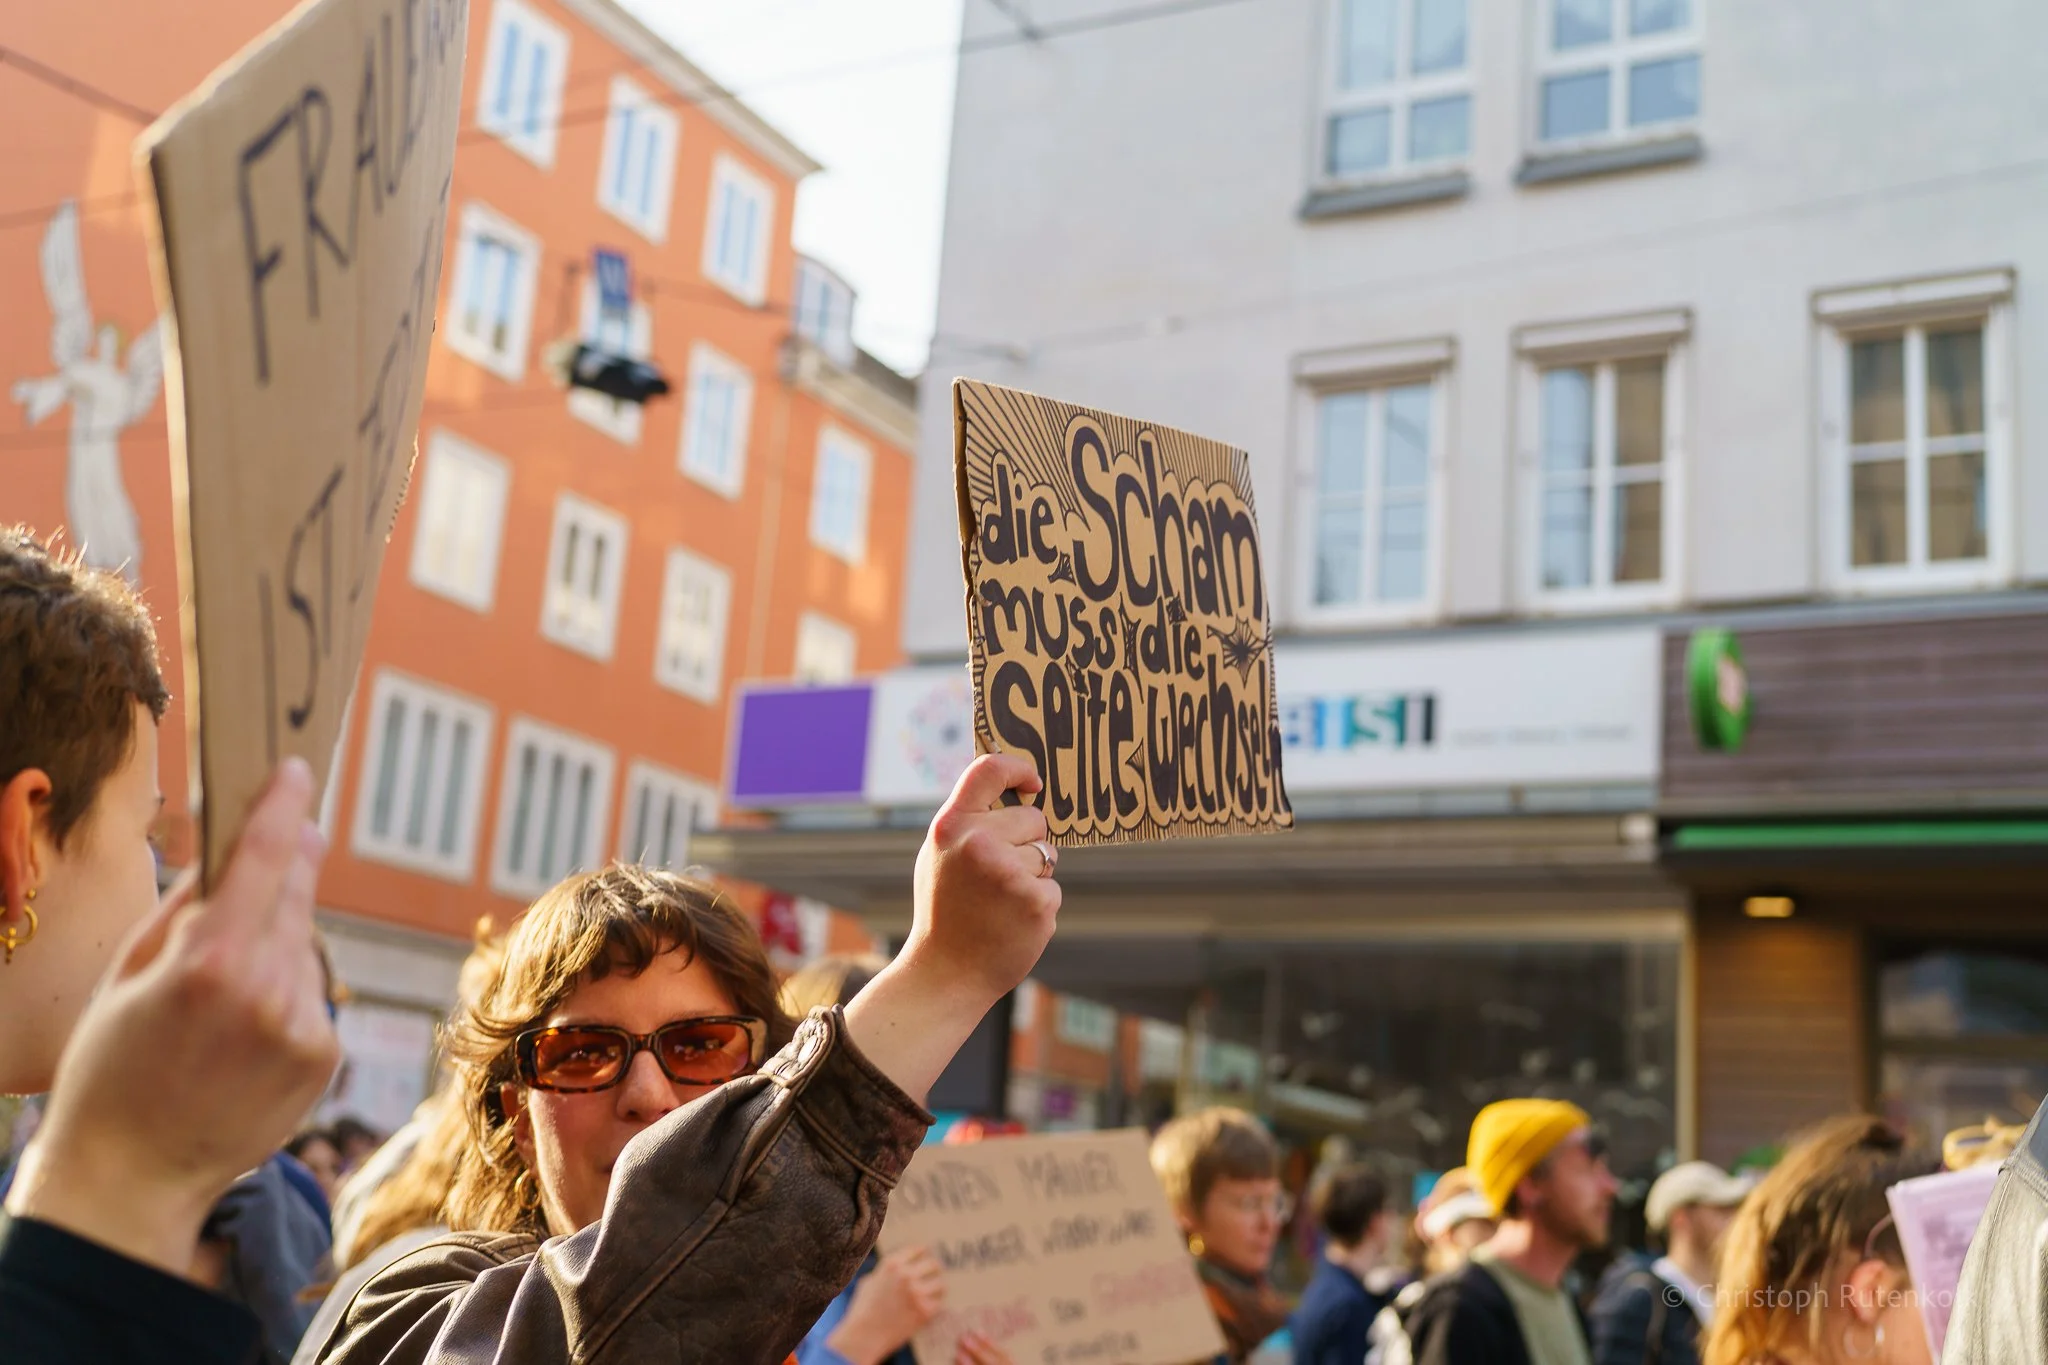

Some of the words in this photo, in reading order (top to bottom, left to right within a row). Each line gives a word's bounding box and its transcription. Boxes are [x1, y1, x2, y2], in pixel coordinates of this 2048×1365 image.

[982, 464, 1058, 565] die
[1071, 427, 1262, 620] Scham
[257, 463, 346, 768] IST
[979, 578, 1117, 670] muss
[1140, 596, 1205, 681] die
[990, 660, 1141, 821] Seite
